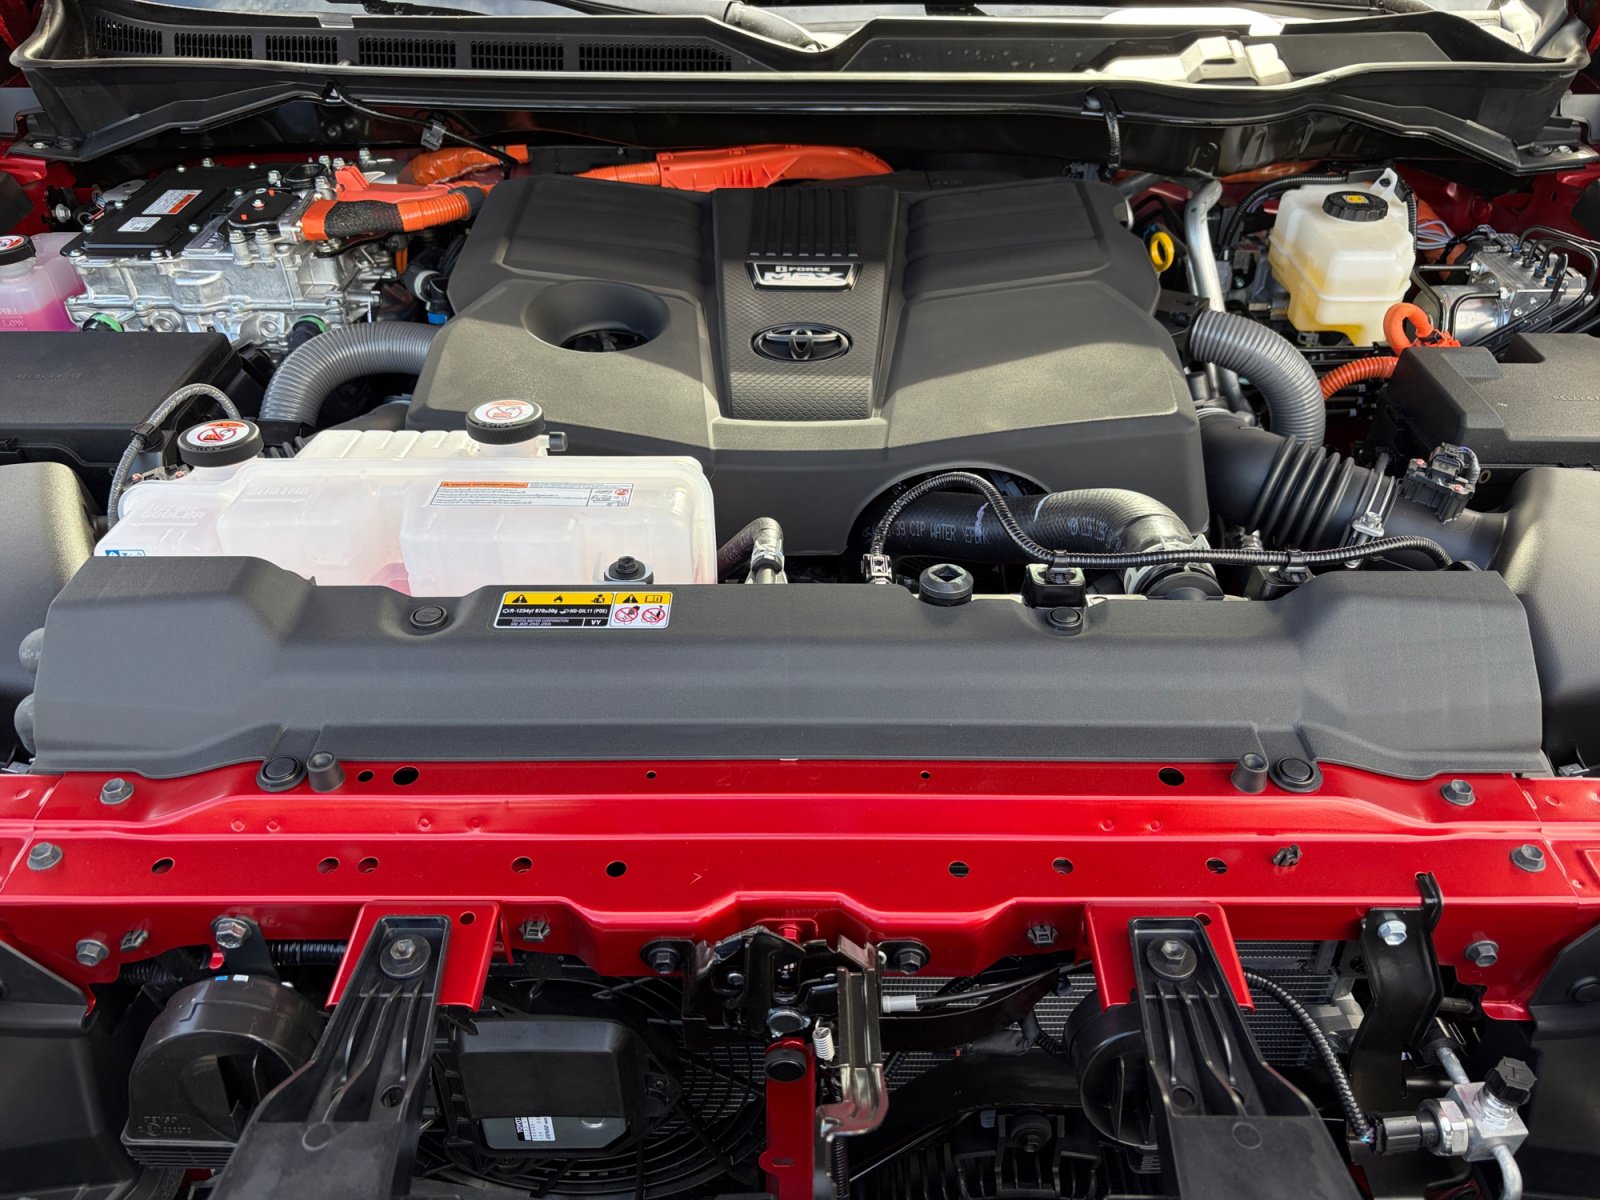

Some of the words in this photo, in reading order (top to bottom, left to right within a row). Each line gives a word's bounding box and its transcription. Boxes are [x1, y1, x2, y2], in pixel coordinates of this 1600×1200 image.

[763, 272, 845, 281] MAX
[909, 519, 926, 538] CIP
[929, 522, 957, 542] WATER
[543, 1125, 551, 1140] DENSO
